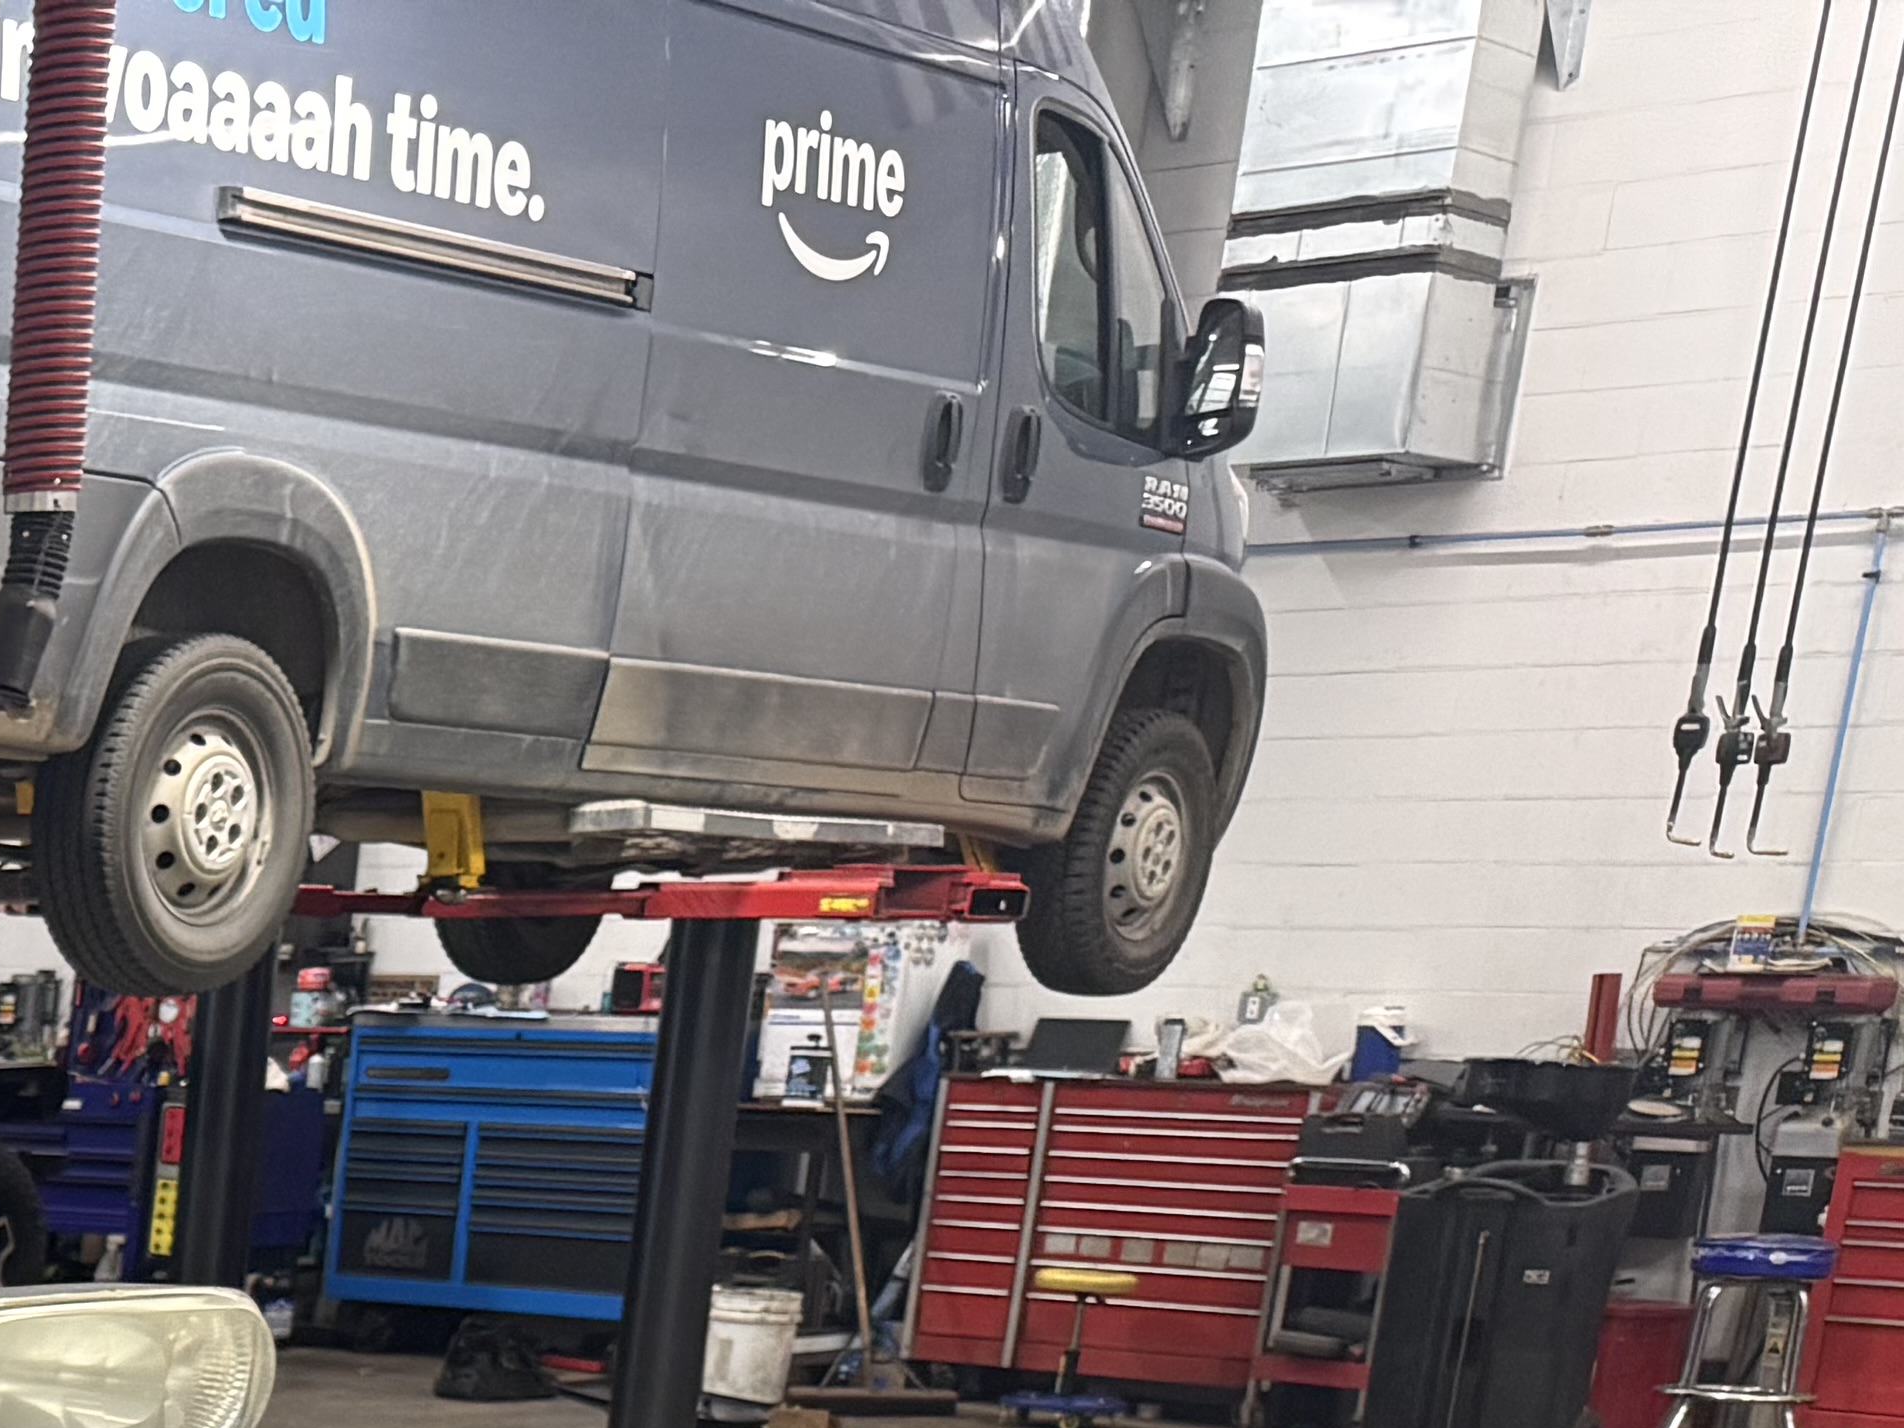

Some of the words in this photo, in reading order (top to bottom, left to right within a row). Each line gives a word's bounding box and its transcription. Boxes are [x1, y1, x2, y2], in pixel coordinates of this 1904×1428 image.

[386, 93, 545, 222] time.
[761, 110, 905, 217] prime
[1141, 492, 1188, 519] 3500
